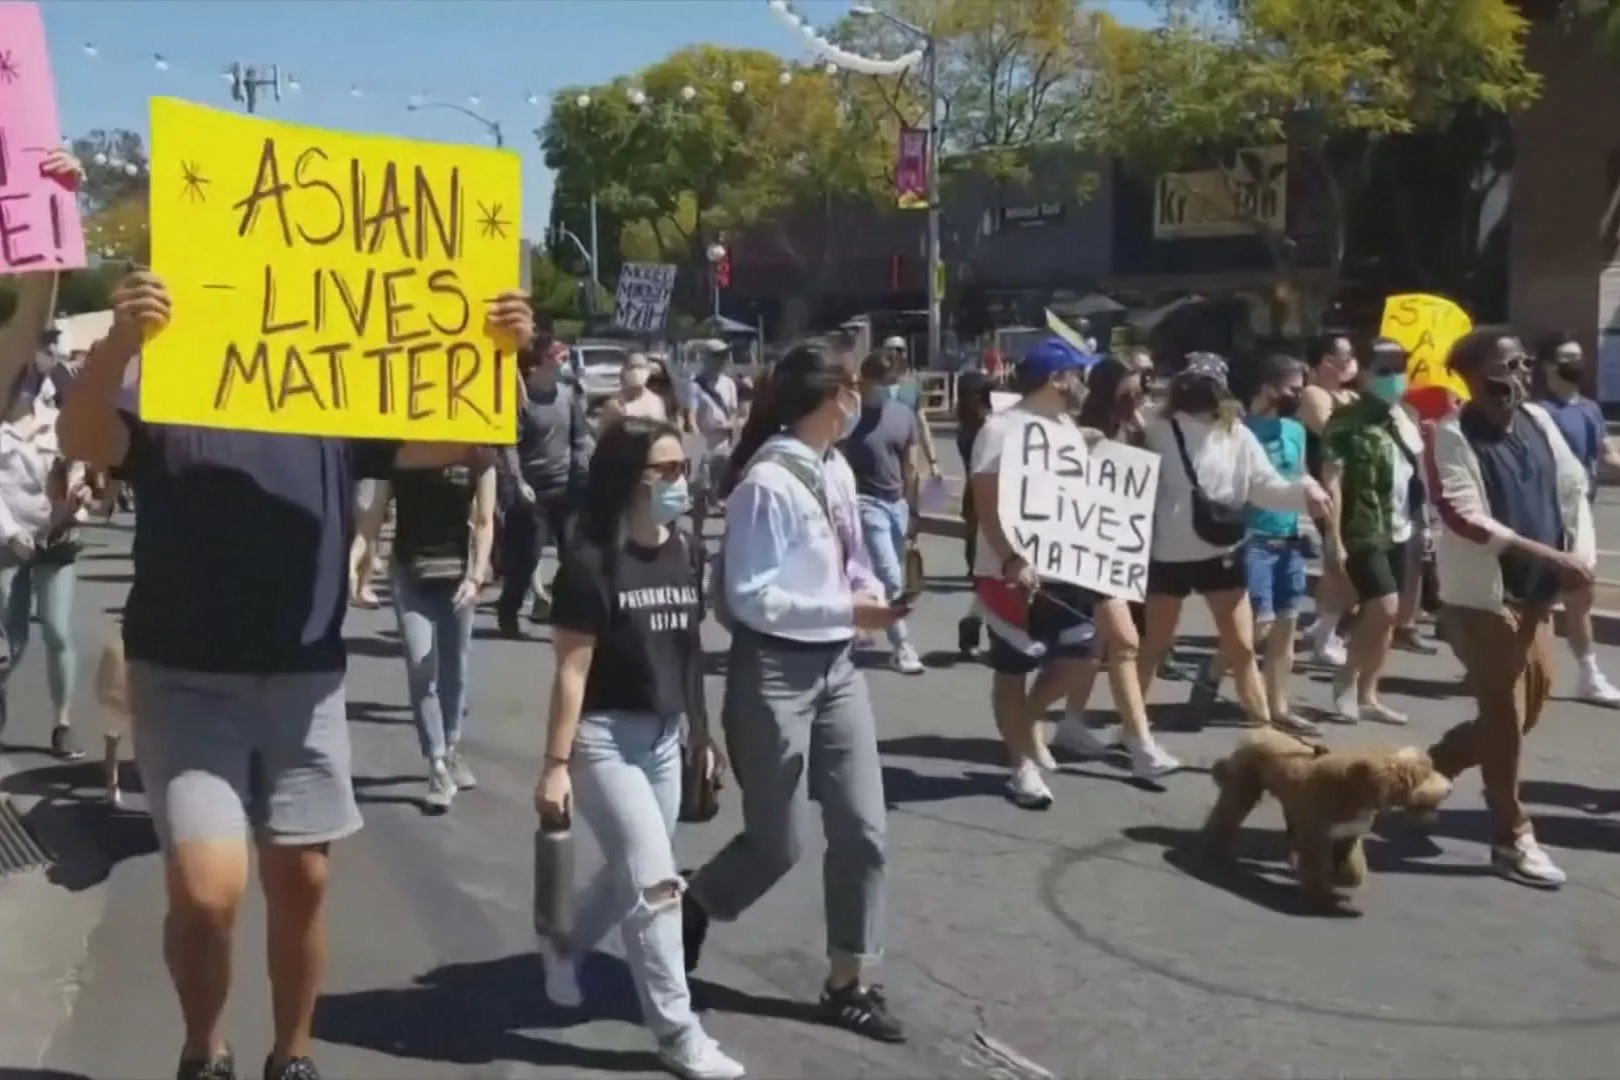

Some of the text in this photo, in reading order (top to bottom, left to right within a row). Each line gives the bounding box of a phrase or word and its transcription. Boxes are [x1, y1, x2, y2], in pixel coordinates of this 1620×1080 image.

[233, 137, 466, 261] ASIAN
[260, 264, 470, 345] LIVES
[213, 342, 504, 430] MATTER!
[1022, 421, 1151, 499] ASIAN
[1013, 525, 1147, 599] MATTER
